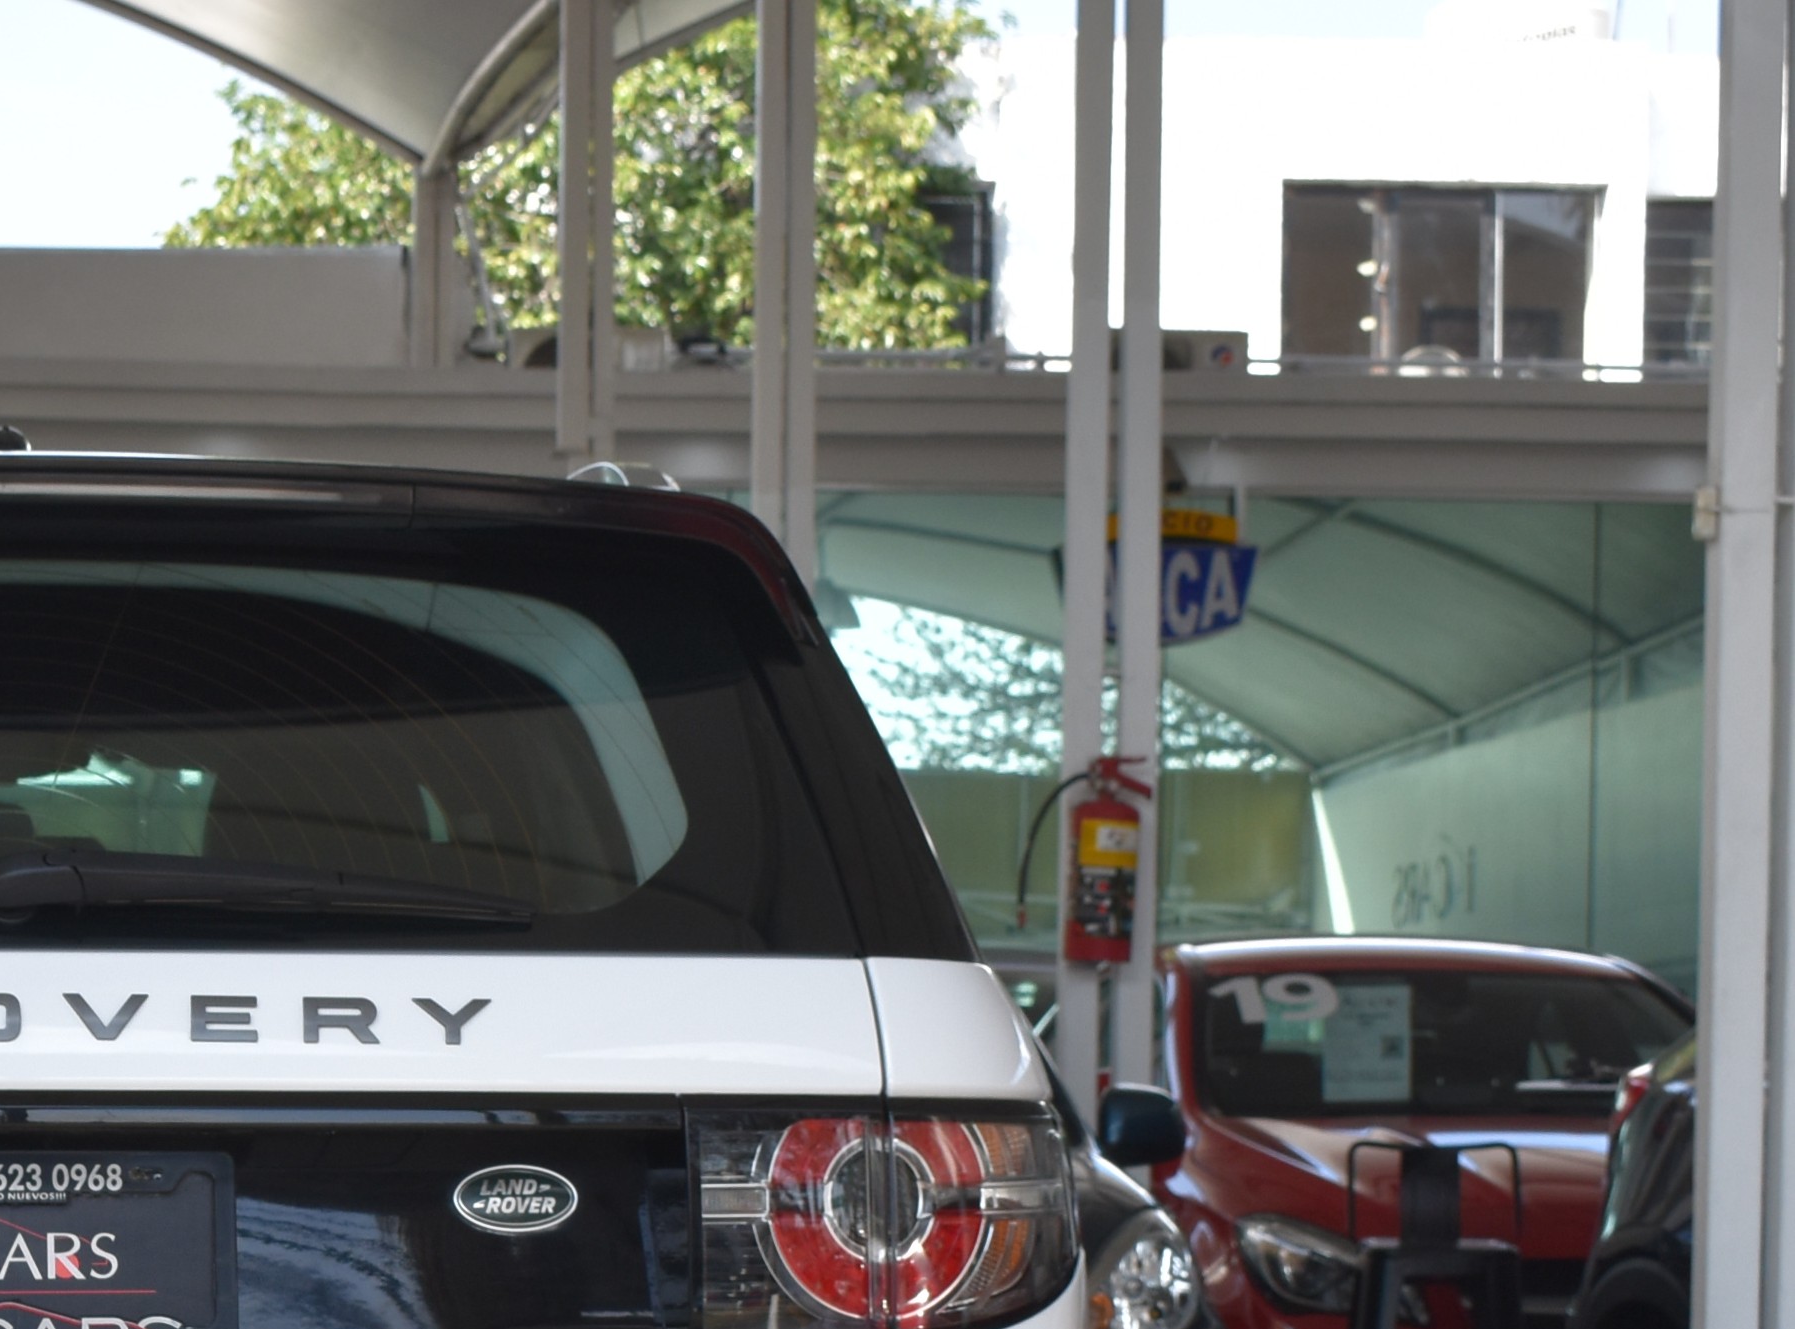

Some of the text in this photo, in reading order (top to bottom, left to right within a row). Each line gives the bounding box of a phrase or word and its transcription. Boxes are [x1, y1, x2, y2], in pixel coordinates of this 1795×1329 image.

[1208, 973, 1339, 1023] 19
[51, 1163, 123, 1192] 0968
[7, 1191, 66, 1201] NUEVOS!!!
[479, 1178, 538, 1196] LAND
[485, 1196, 557, 1214] ROVER
